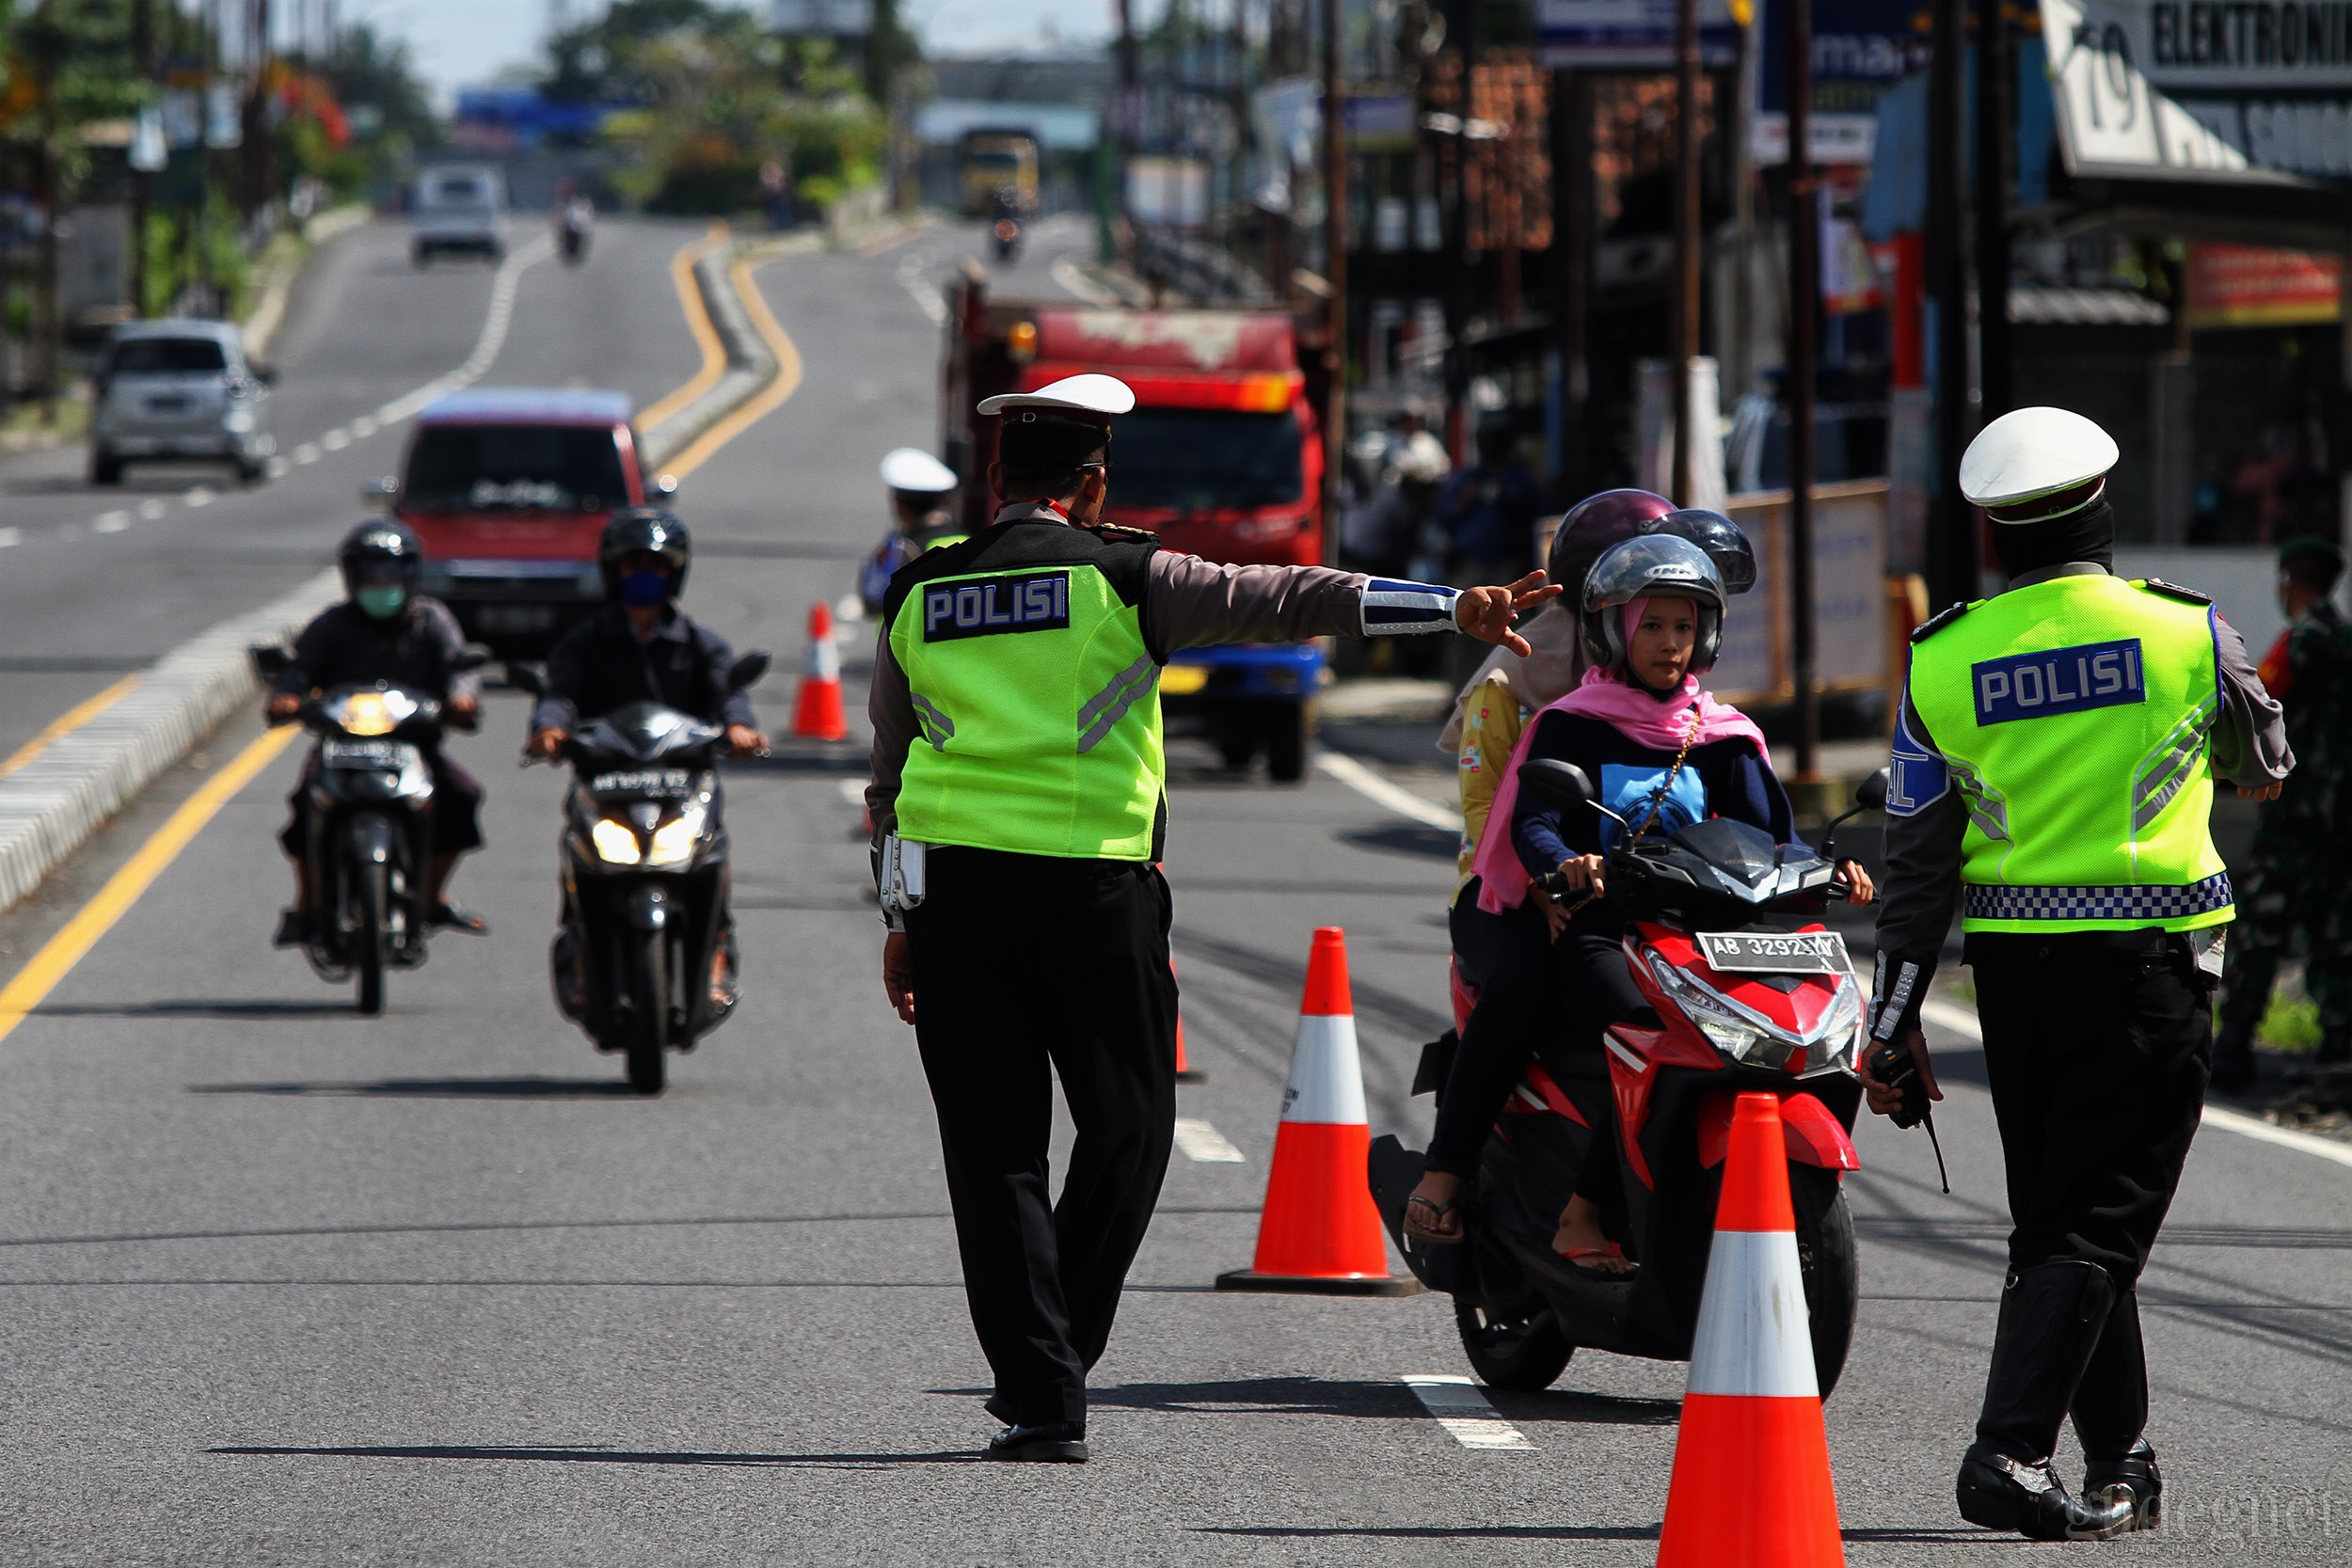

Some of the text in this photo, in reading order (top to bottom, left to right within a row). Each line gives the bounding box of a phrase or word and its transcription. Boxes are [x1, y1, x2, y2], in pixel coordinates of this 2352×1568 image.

[927, 578, 1065, 632] POLISI
[1980, 647, 2140, 713] POLISI
[1714, 939, 1740, 956] AB
[1748, 939, 1807, 957] 3292
